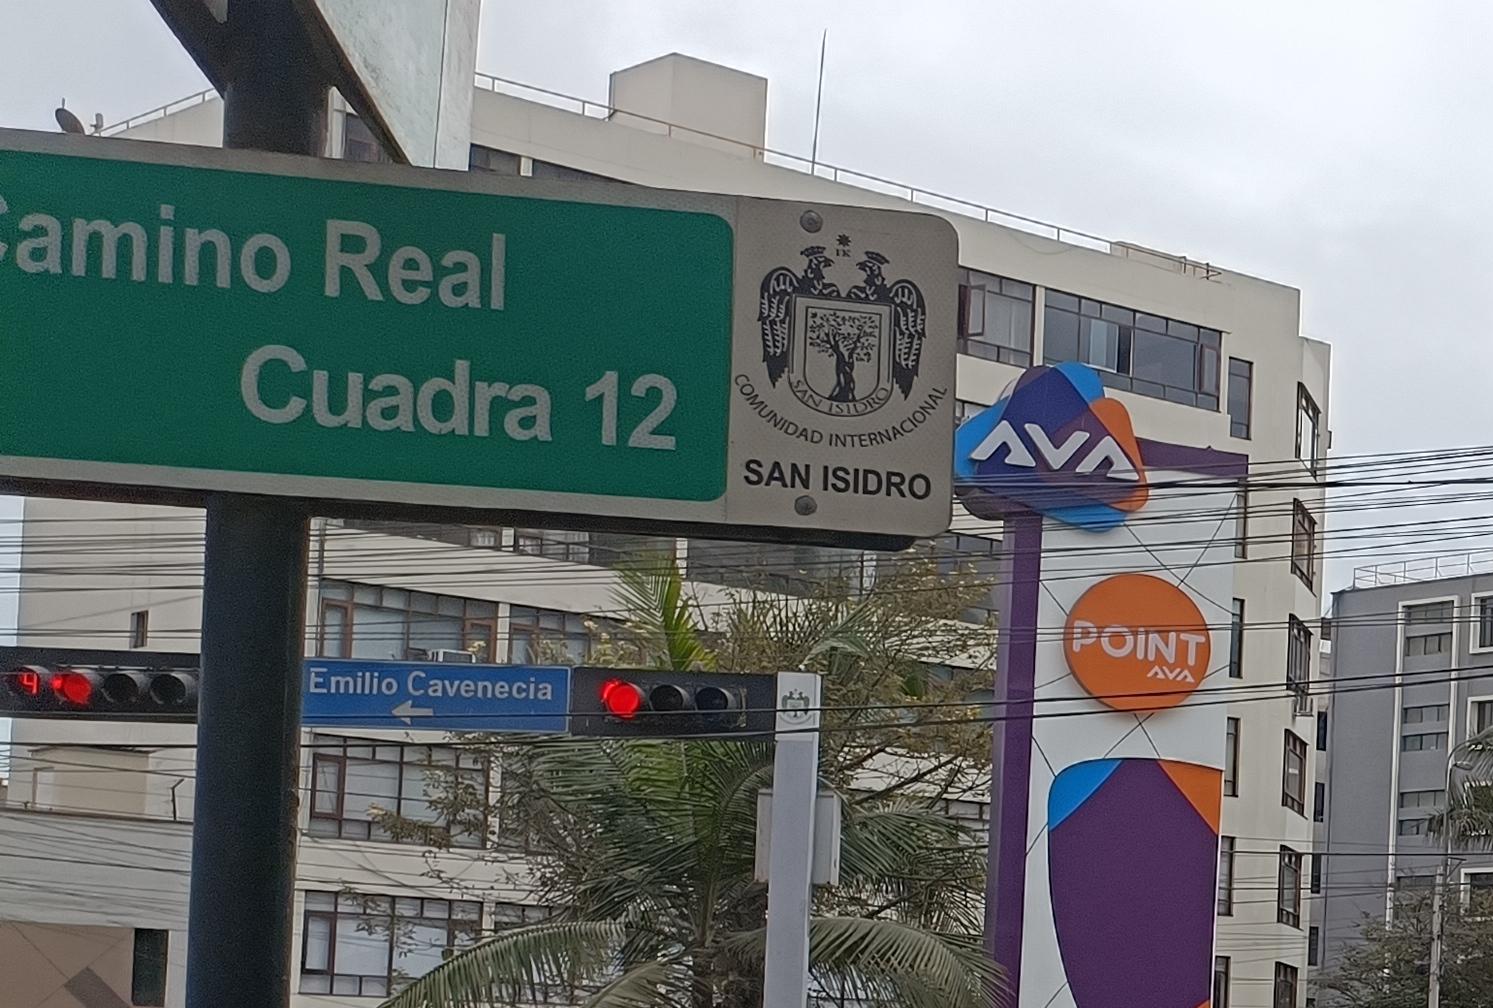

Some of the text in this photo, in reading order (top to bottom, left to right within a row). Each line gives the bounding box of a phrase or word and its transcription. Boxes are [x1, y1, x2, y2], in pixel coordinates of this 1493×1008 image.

[0, 194, 506, 311] amino Real
[240, 345, 677, 451] Cuadra 12
[734, 374, 948, 448] COMUNIDAD INTERNACIONAL
[792, 379, 890, 415] SAN ISIDRO
[970, 419, 1140, 481] AVA
[744, 459, 932, 500] SAN ISIDRO
[1072, 619, 1206, 668] POINT
[309, 667, 553, 701] Emilio Cavenecia
[1147, 665, 1195, 683] AVA
